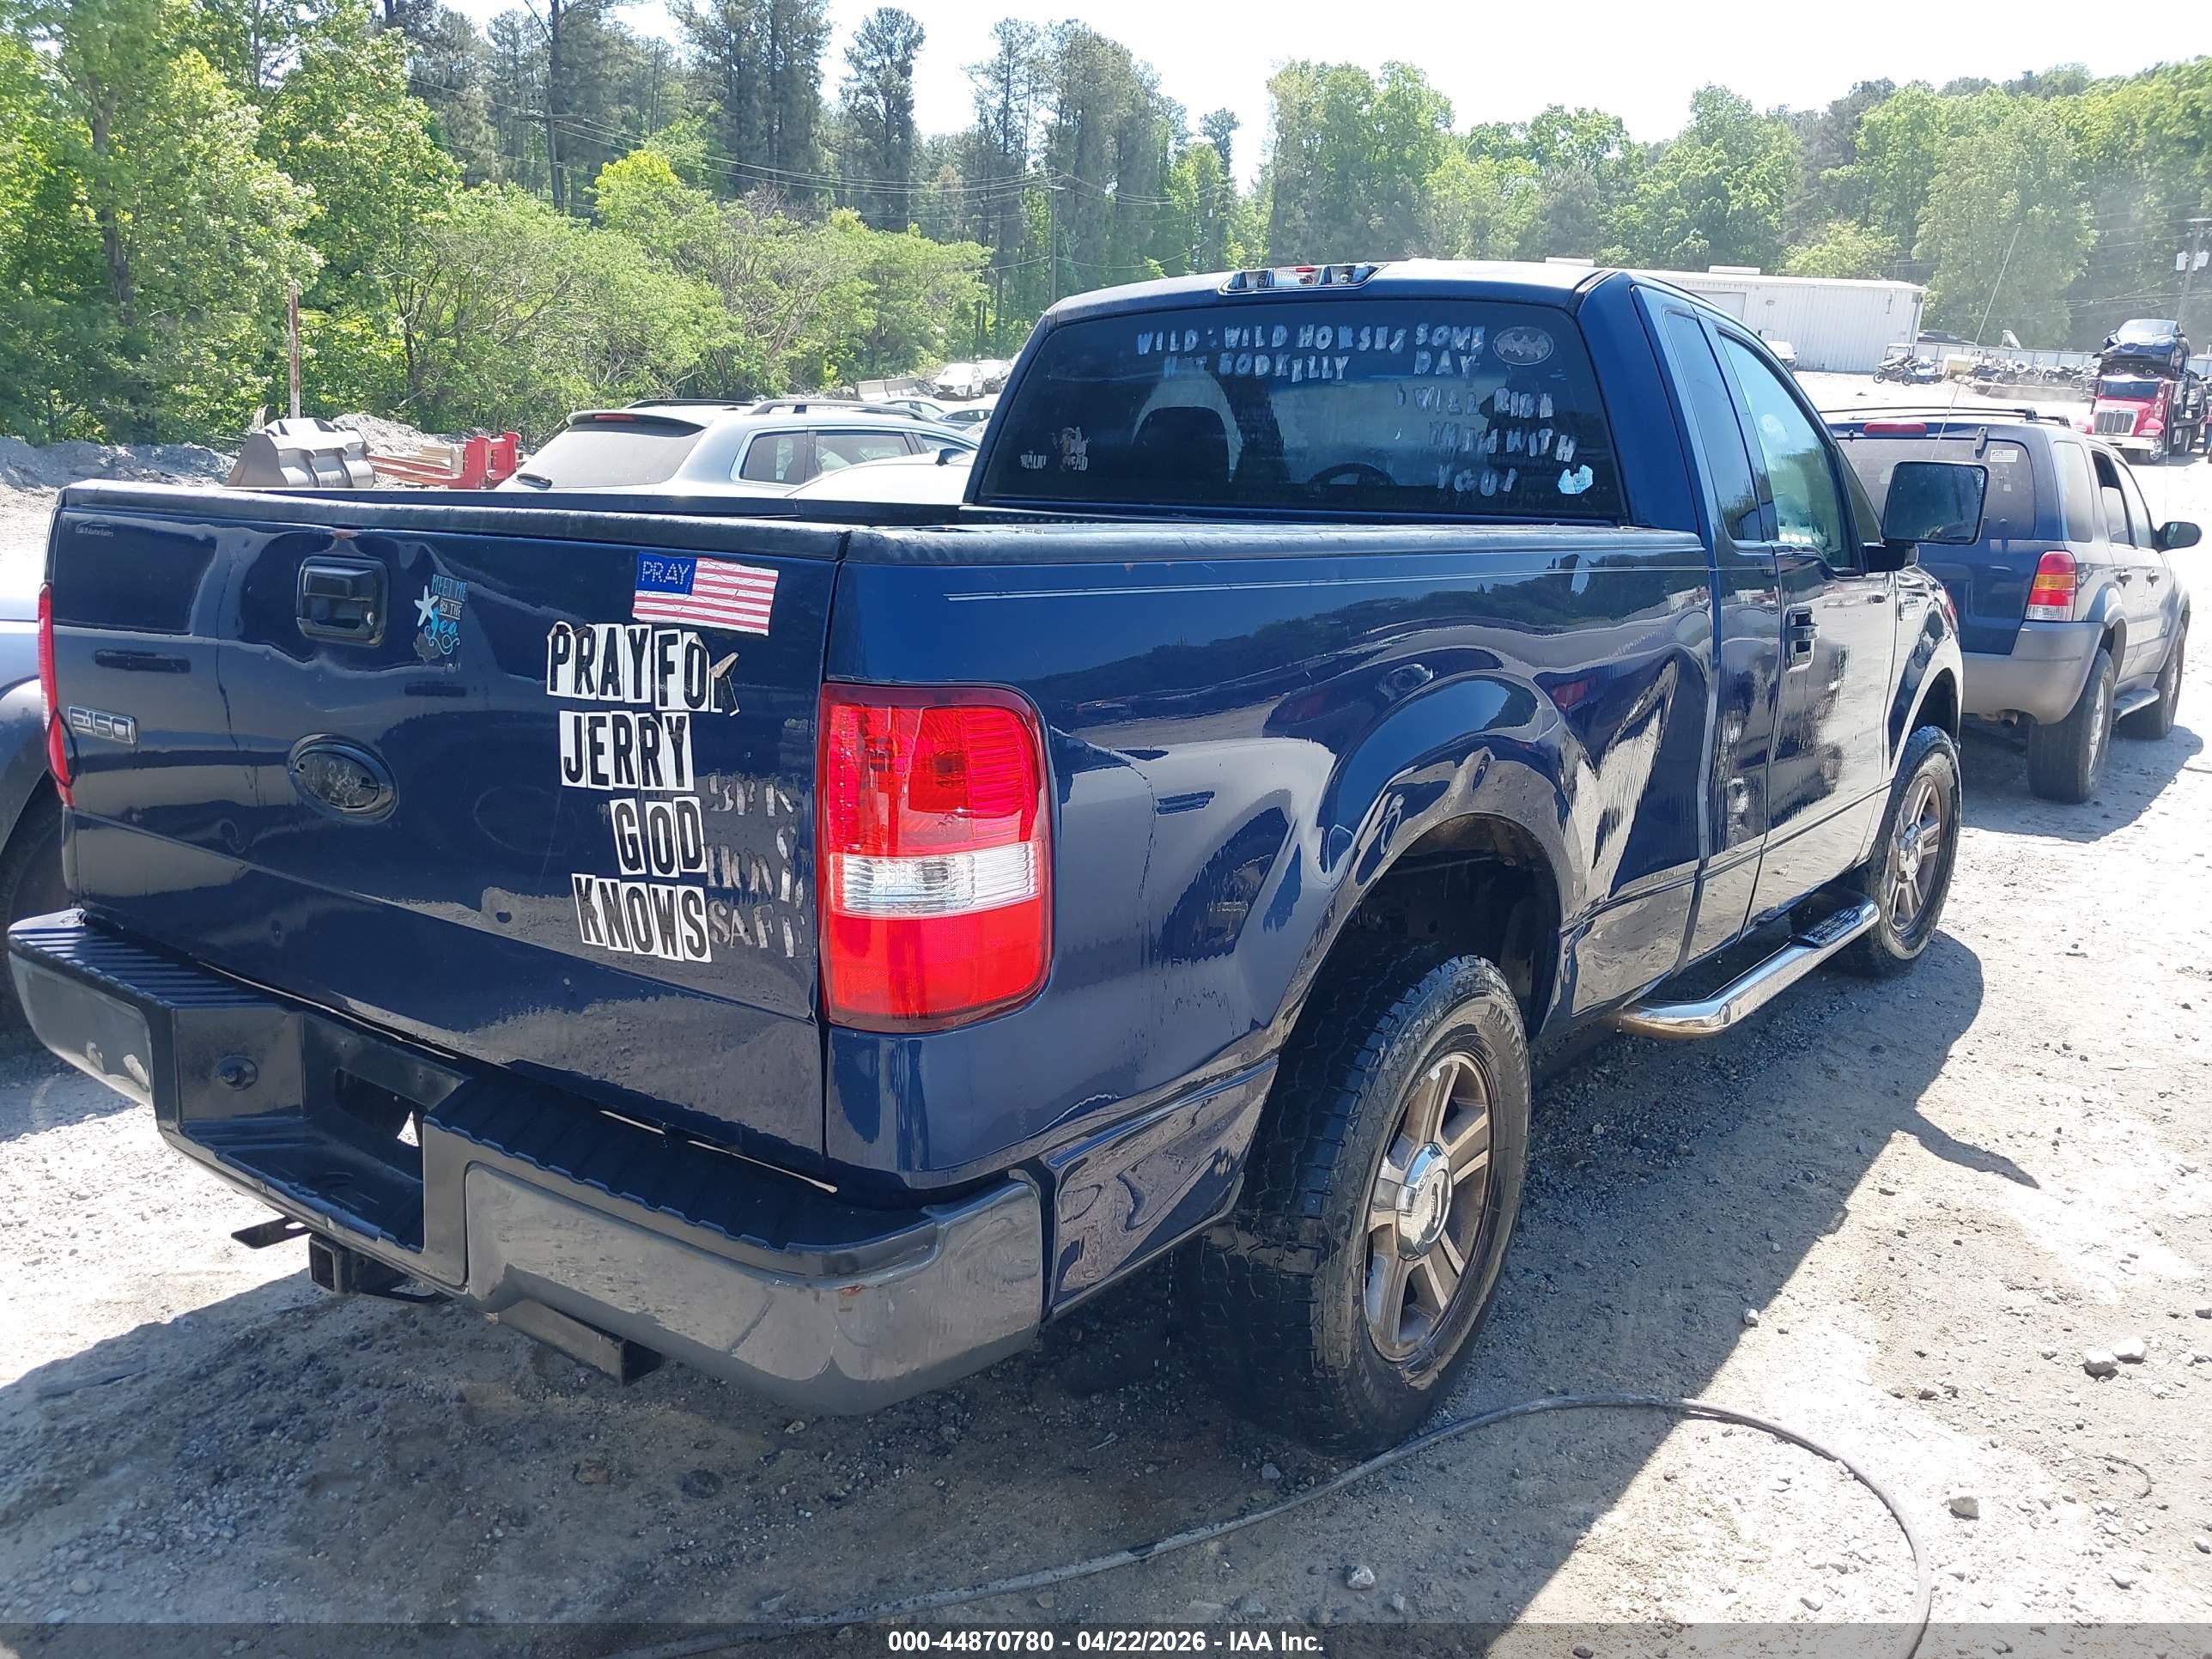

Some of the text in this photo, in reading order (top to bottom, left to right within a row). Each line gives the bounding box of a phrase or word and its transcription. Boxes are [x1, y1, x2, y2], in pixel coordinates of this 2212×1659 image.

[1137, 329, 1200, 355] WILD
[1224, 325, 1288, 349] WILD
[1416, 323, 1486, 354] SOME
[1413, 349, 1480, 380] DAY
[431, 574, 468, 602] MEET ME
[641, 560, 690, 586] PRAY
[440, 599, 462, 617] BY THE
[561, 712, 693, 790] JERRY
[611, 797, 707, 876] GOD
[573, 874, 711, 962] KNOWS
